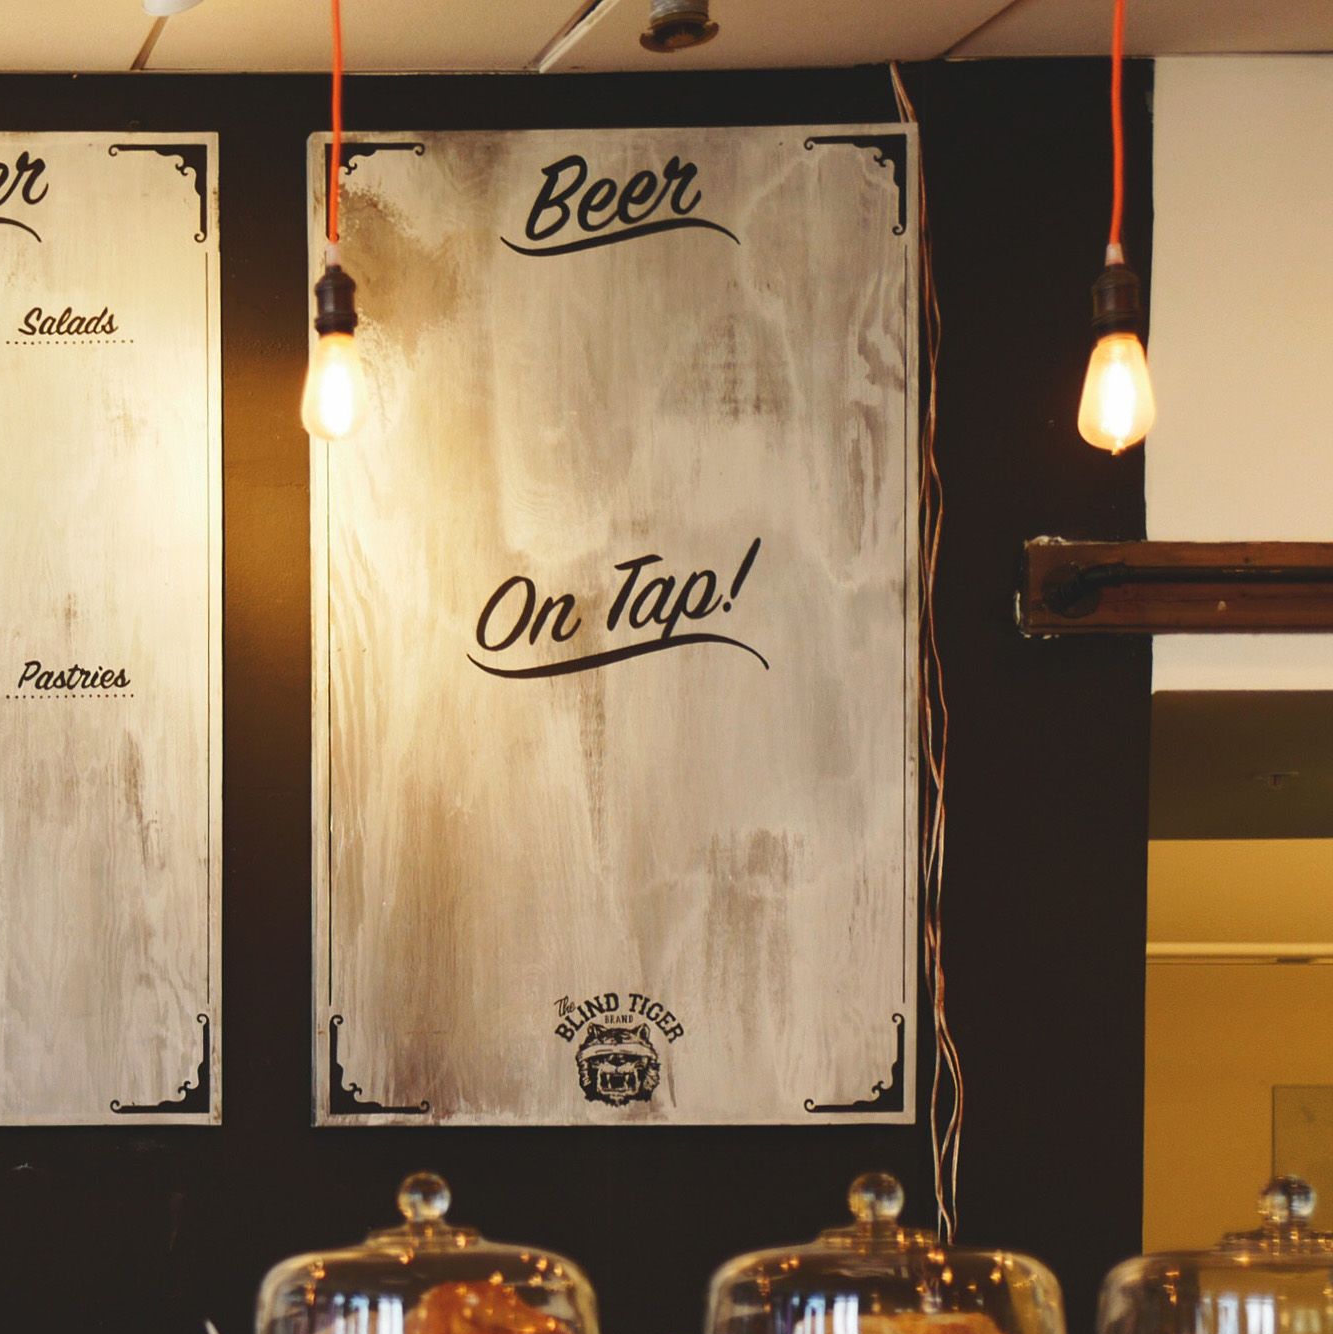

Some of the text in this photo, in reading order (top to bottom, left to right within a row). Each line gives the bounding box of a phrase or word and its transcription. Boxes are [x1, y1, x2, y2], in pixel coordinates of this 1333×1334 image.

[524, 153, 703, 241] Beer
[18, 306, 118, 337] Salads
[475, 537, 762, 652] On Tap!
[18, 661, 131, 691] Pastries
[553, 995, 576, 1017] The
[554, 992, 685, 1044] BLIND TIGER
[604, 1014, 634, 1024] BRAND
